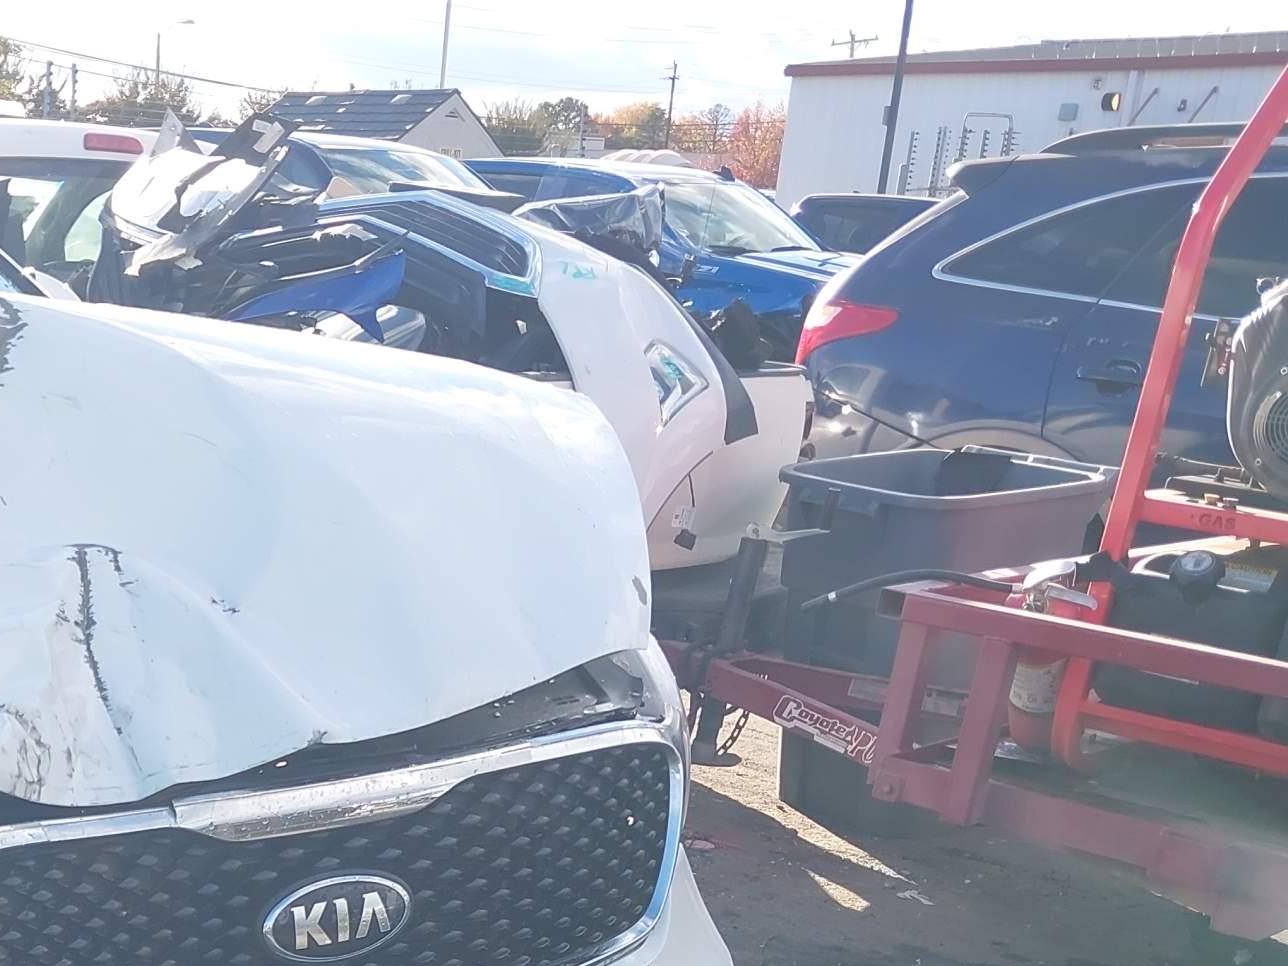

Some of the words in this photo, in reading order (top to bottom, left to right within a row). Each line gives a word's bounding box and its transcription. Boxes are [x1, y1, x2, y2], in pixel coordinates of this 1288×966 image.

[1198, 512, 1236, 530] GAS
[773, 695, 849, 739] Coyote
[290, 891, 391, 950] KIA
